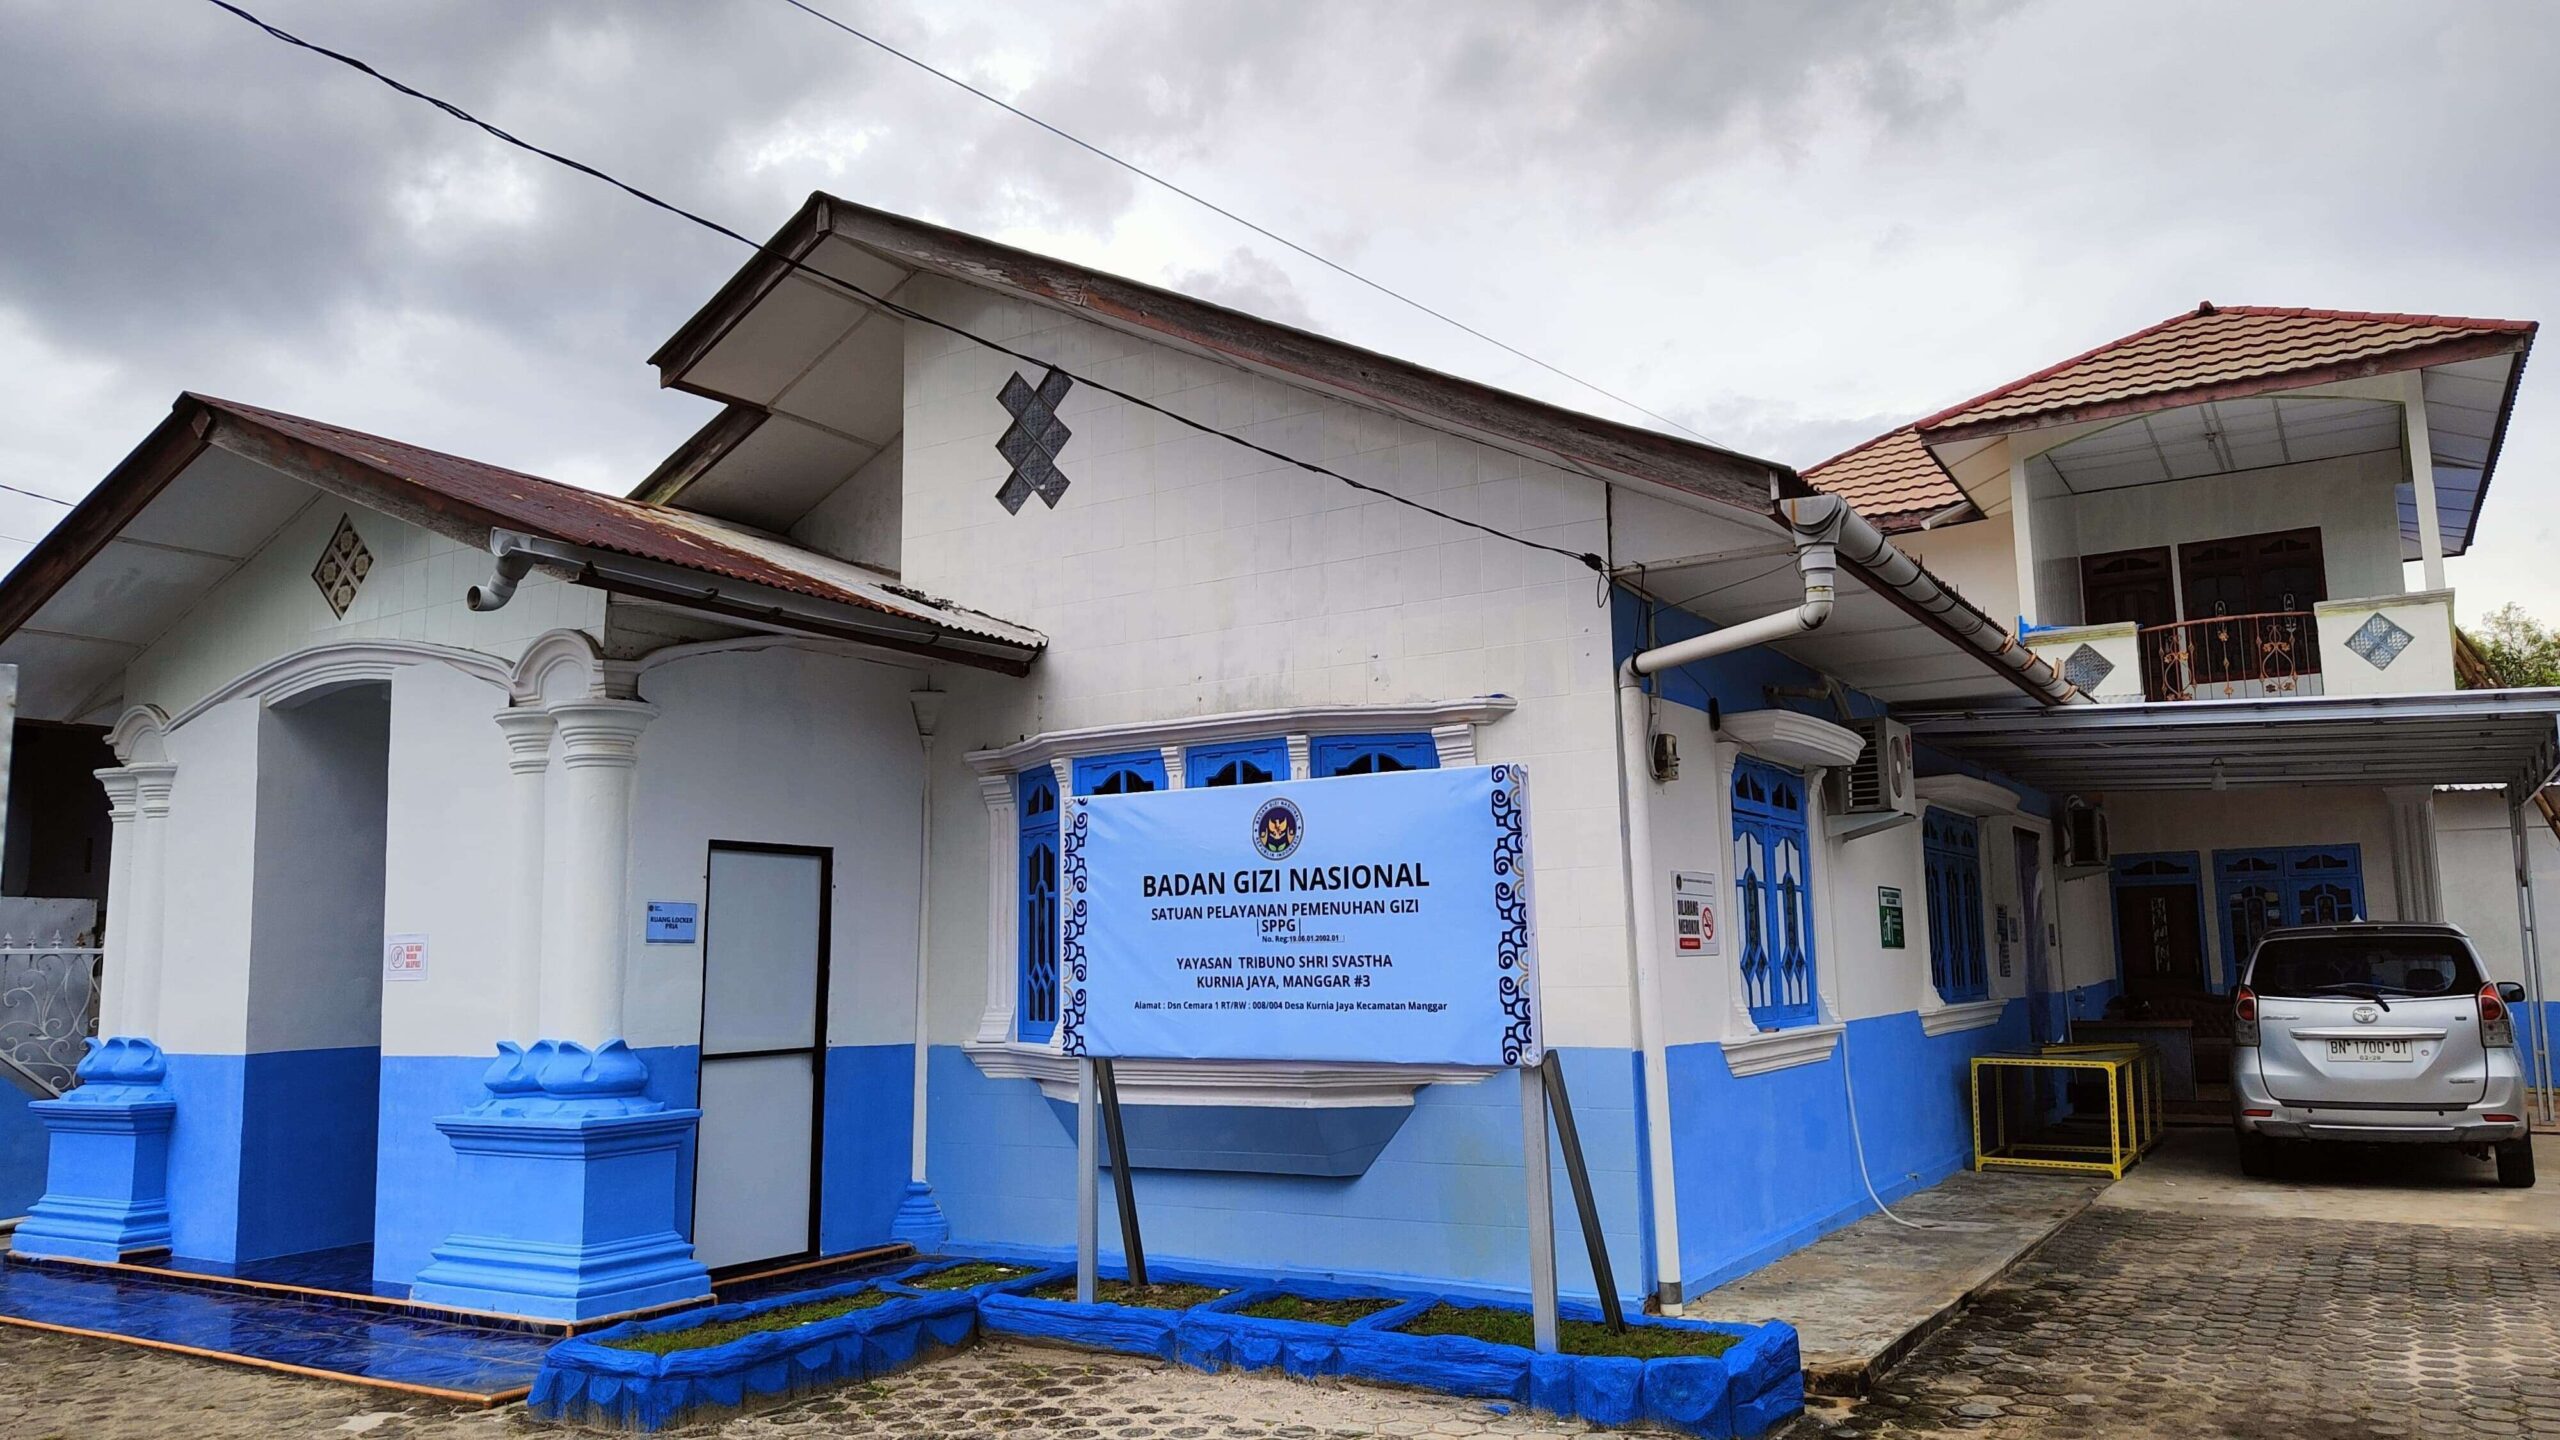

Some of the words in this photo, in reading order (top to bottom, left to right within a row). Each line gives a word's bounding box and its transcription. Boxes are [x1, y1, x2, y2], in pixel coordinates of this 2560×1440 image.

[1143, 871, 1225, 898] BADAN
[1233, 869, 1280, 894] GIZI
[1289, 862, 1430, 892] NASIONAL
[1151, 906, 1203, 921] SATUAN
[1207, 903, 1287, 919] PELAYANAN
[1291, 900, 1385, 917] PEMENUHAN
[1389, 899, 1419, 914] GIZI
[1261, 918, 1296, 933] SPPG
[1261, 935, 1274, 943] No.
[1176, 956, 1232, 970] YAYASAN
[1238, 956, 1296, 969] TRIBUNO
[1298, 955, 1328, 969] SHRI
[1332, 954, 1393, 968] SVASTHA
[1197, 976, 1244, 988] KURNIA
[1245, 975, 1280, 991] JAYA,
[1282, 975, 1351, 988] MANGGAR
[1354, 974, 1371, 988] #3
[1134, 1001, 1161, 1010] Alamat
[1167, 1001, 1182, 1010] Dsn
[1183, 1001, 1213, 1010] Cemara
[1220, 1001, 1247, 1010] RT/RW
[1252, 1001, 1283, 1010] 008/004
[1284, 1001, 1305, 1010] Desa
[1306, 1001, 1335, 1011] Kurnia
[1335, 1001, 1355, 1013] Jaya
[1356, 1001, 1407, 1011] Kecamatan
[1408, 1002, 1448, 1013] Manggar
[2330, 1040, 2347, 1055] BN
[2354, 1040, 2385, 1054] 1700
